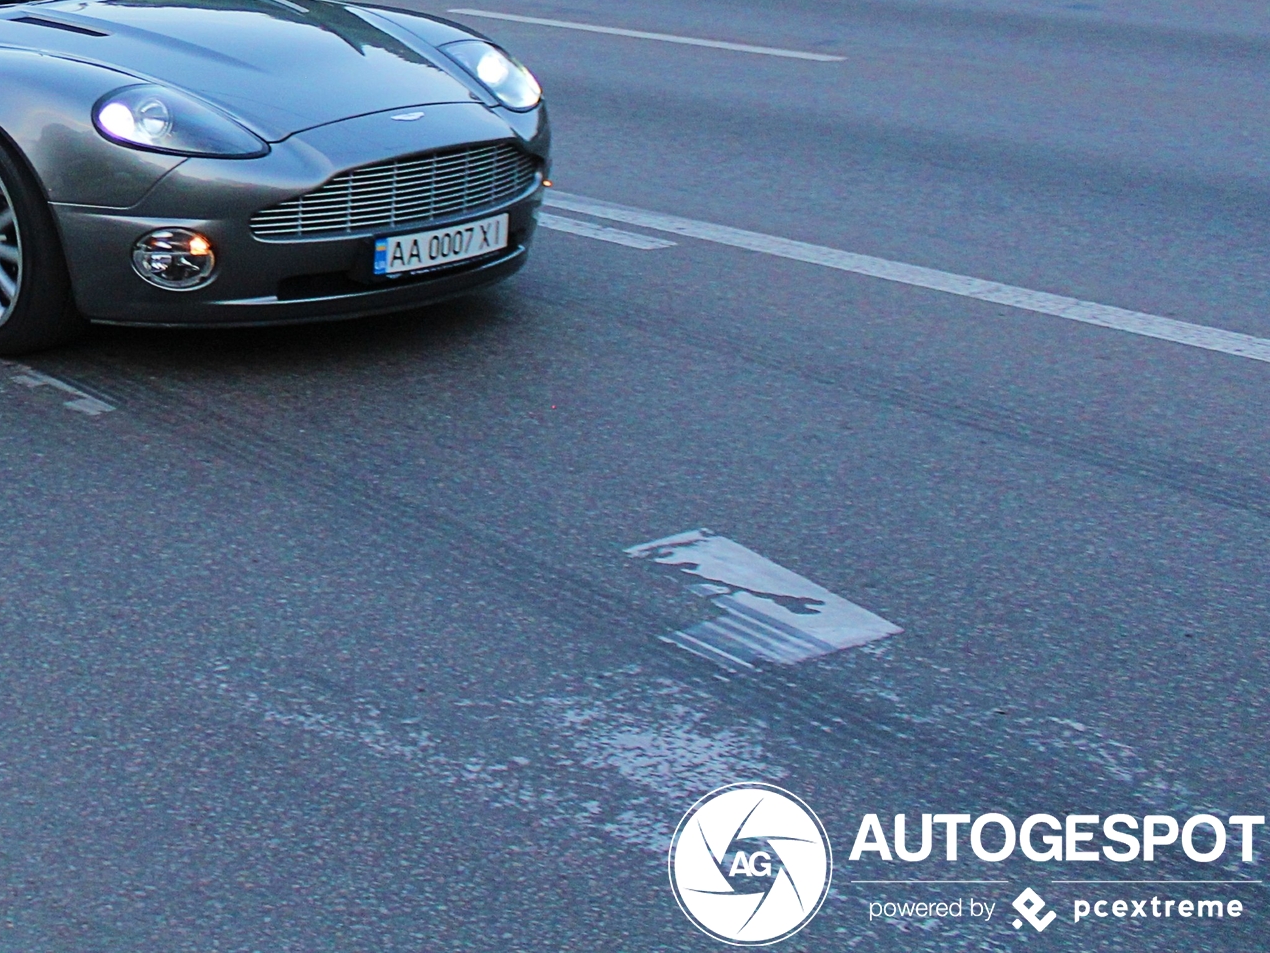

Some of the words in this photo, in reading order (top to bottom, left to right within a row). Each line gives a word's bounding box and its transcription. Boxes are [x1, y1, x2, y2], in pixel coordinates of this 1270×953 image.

[390, 239, 422, 267] AA
[428, 227, 474, 261] 0007
[479, 220, 500, 250] XI
